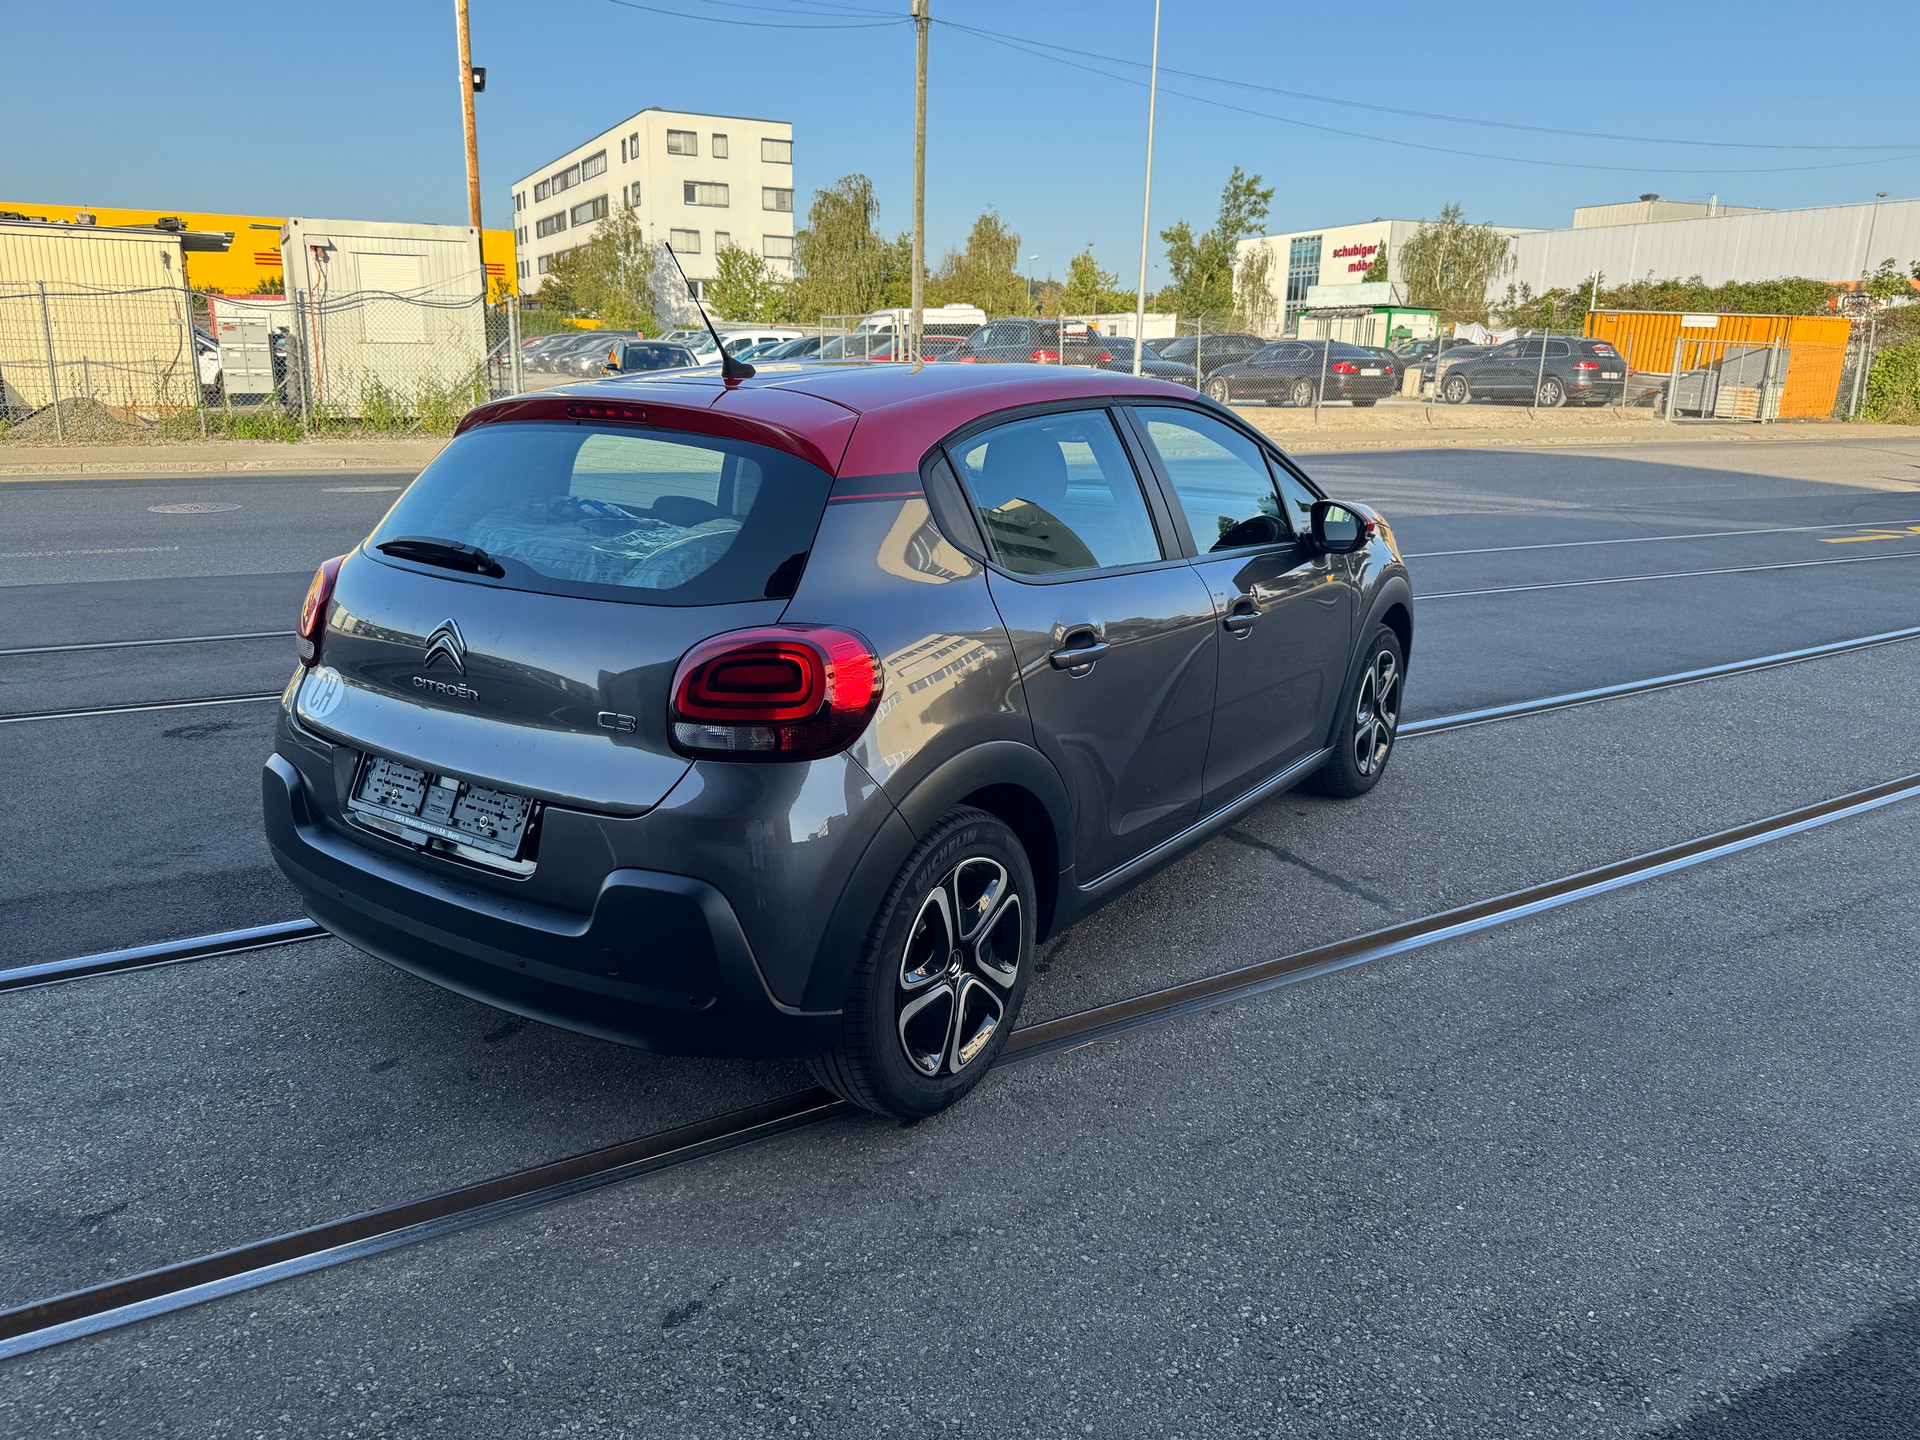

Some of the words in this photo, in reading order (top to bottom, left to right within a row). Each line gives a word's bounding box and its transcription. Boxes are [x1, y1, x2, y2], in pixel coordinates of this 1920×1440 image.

[1333, 244, 1378, 258] schubiger
[1348, 260, 1373, 272] möbe
[309, 673, 338, 714] CH
[412, 676, 479, 701] CITROËN
[598, 711, 636, 733] C3
[394, 814, 405, 823] PSA
[447, 830, 460, 840] Bern
[914, 828, 978, 894] MICHELIN
